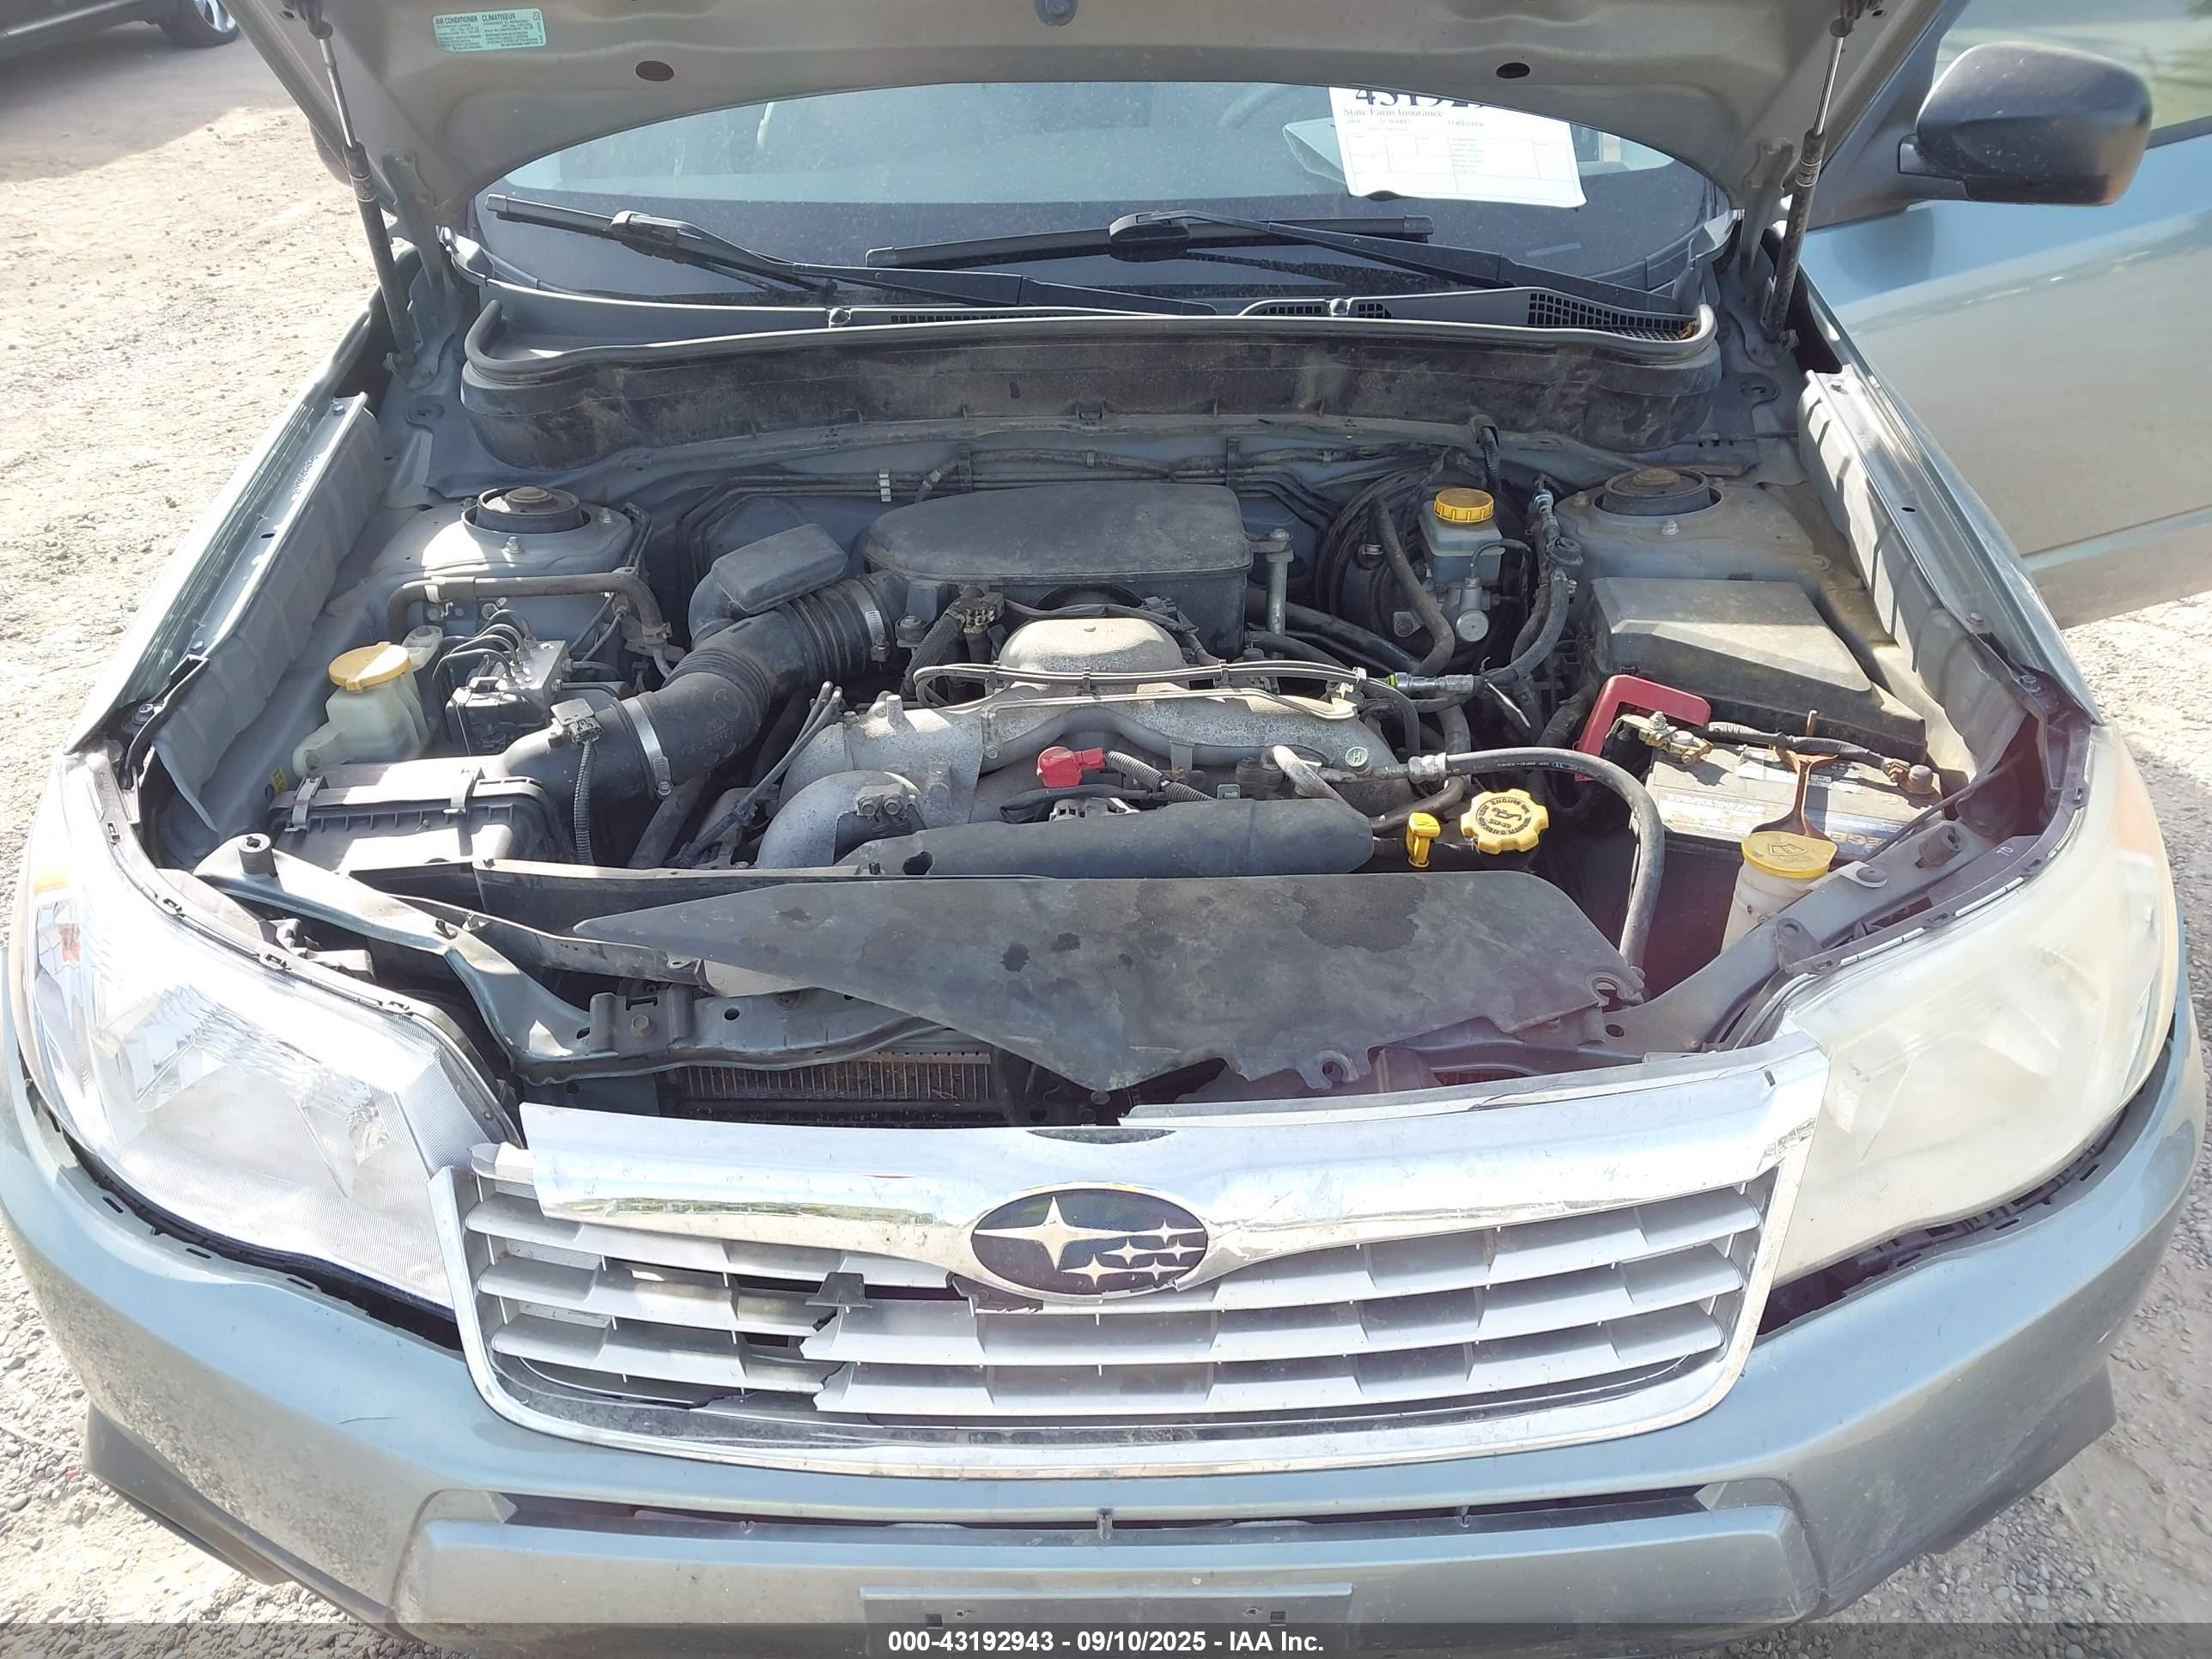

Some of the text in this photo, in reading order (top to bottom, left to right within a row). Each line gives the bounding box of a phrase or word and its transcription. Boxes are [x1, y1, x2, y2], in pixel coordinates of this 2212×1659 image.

[445, 15, 478, 24] CONDITIONER
[482, 13, 516, 21] CLIMATISEUR
[1343, 107, 1443, 118] State Farm Insurance
